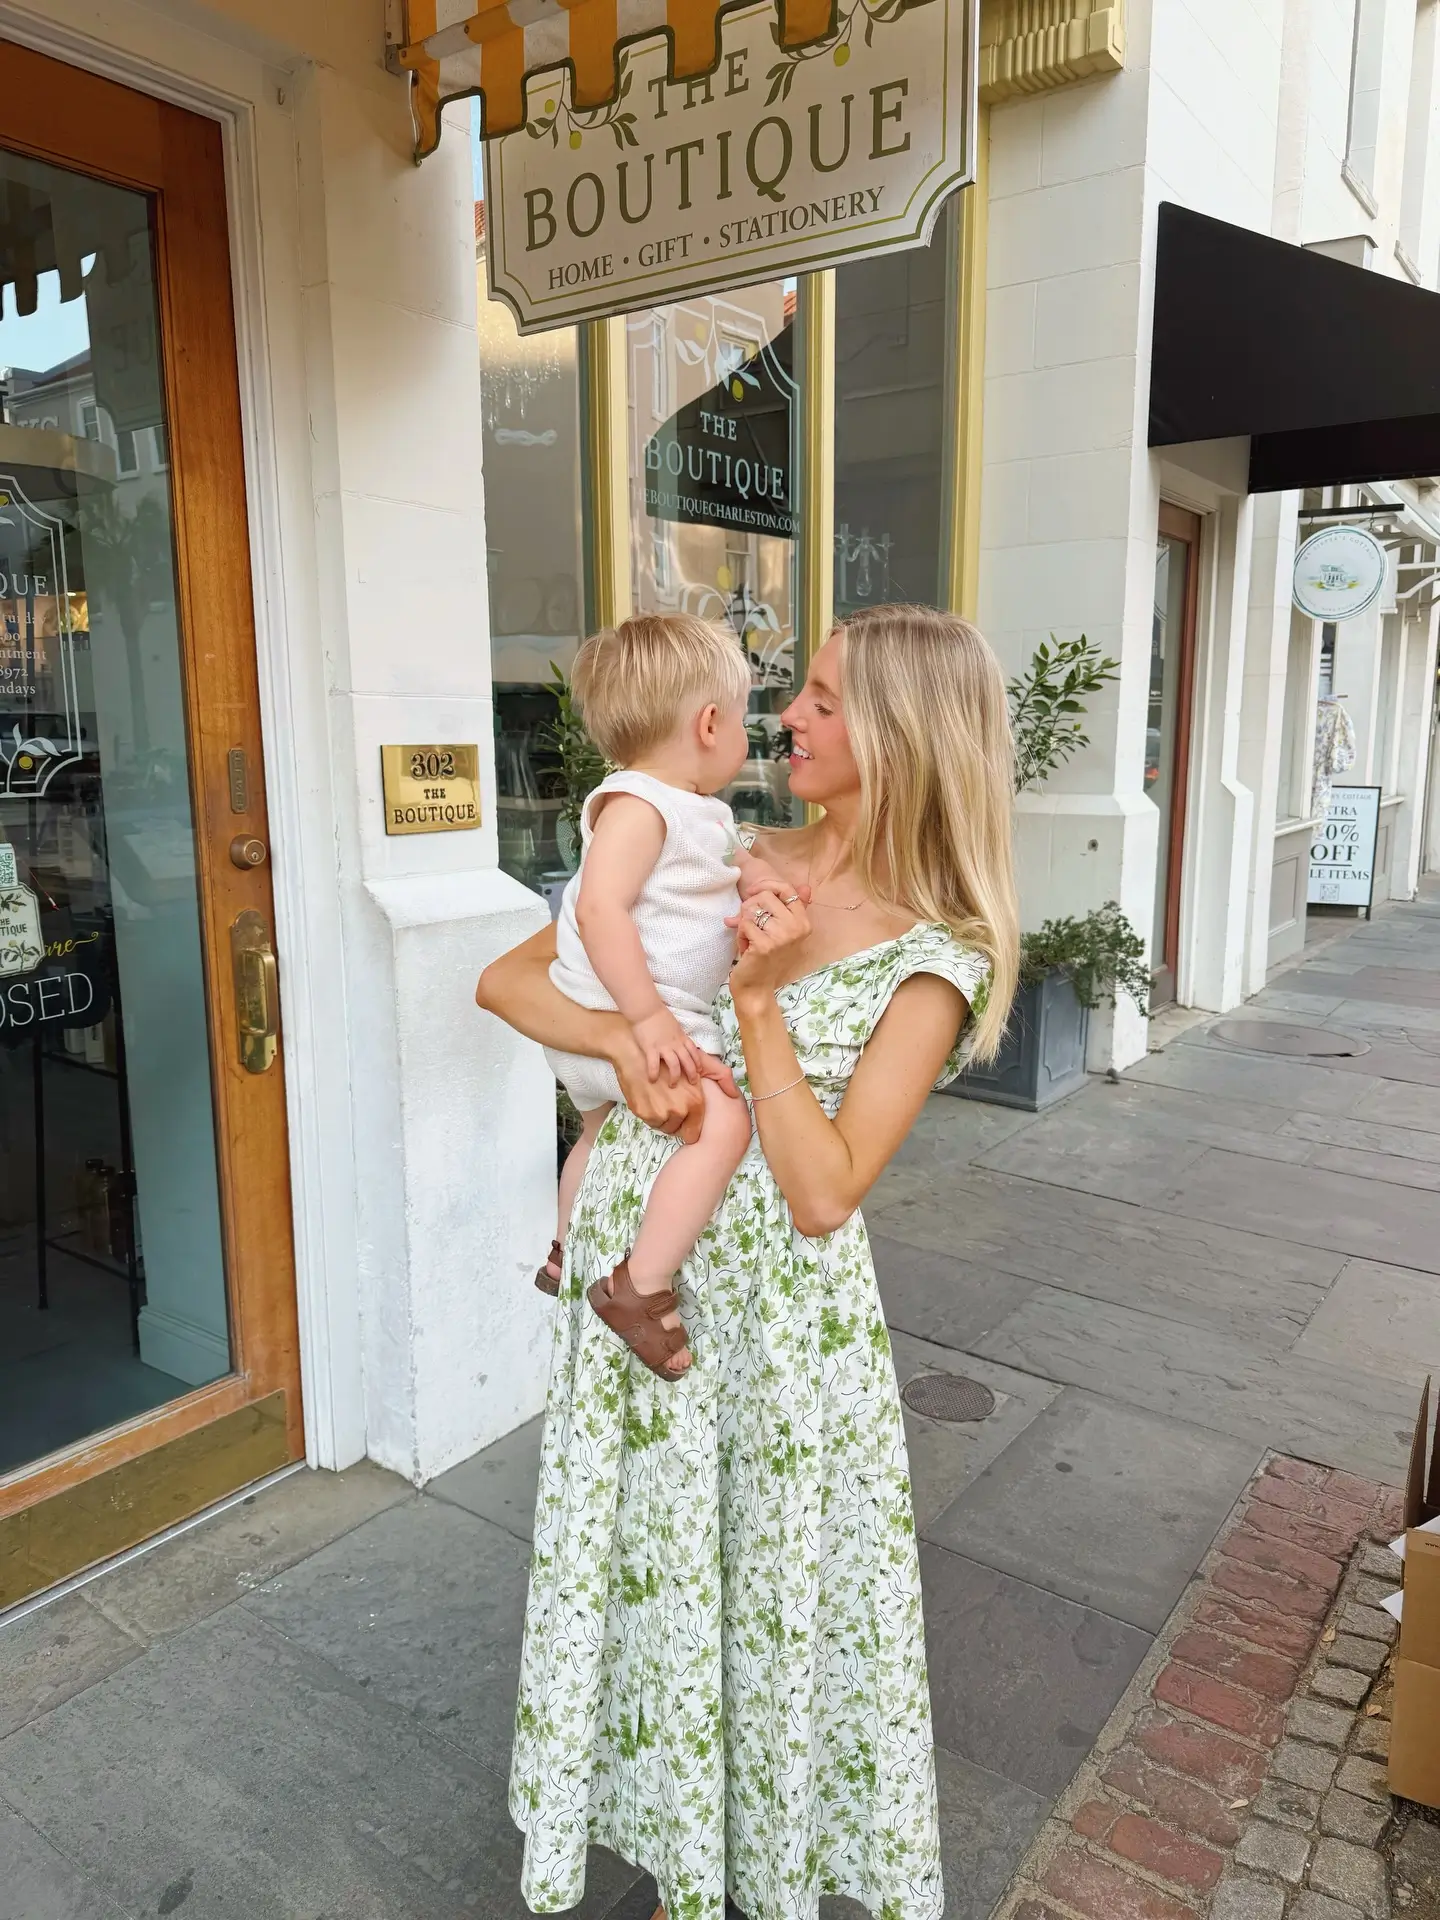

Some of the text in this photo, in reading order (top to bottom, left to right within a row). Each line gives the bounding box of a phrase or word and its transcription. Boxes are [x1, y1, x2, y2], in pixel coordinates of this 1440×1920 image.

[647, 47, 749, 120] THE
[524, 77, 912, 252] BOUTIQUE
[547, 185, 886, 290] HOME GIFT STATIONERY
[700, 411, 737, 441] THE
[643, 434, 784, 500] BOUTIQUE
[411, 753, 455, 778] 302
[424, 788, 446, 800] THE
[394, 804, 476, 824] BOUTIQUE
[1325, 824, 1360, 842] 0%
[1310, 844, 1360, 861] OFF
[1310, 868, 1370, 881] LE ITEMS
[0, 972, 94, 1028] SED
